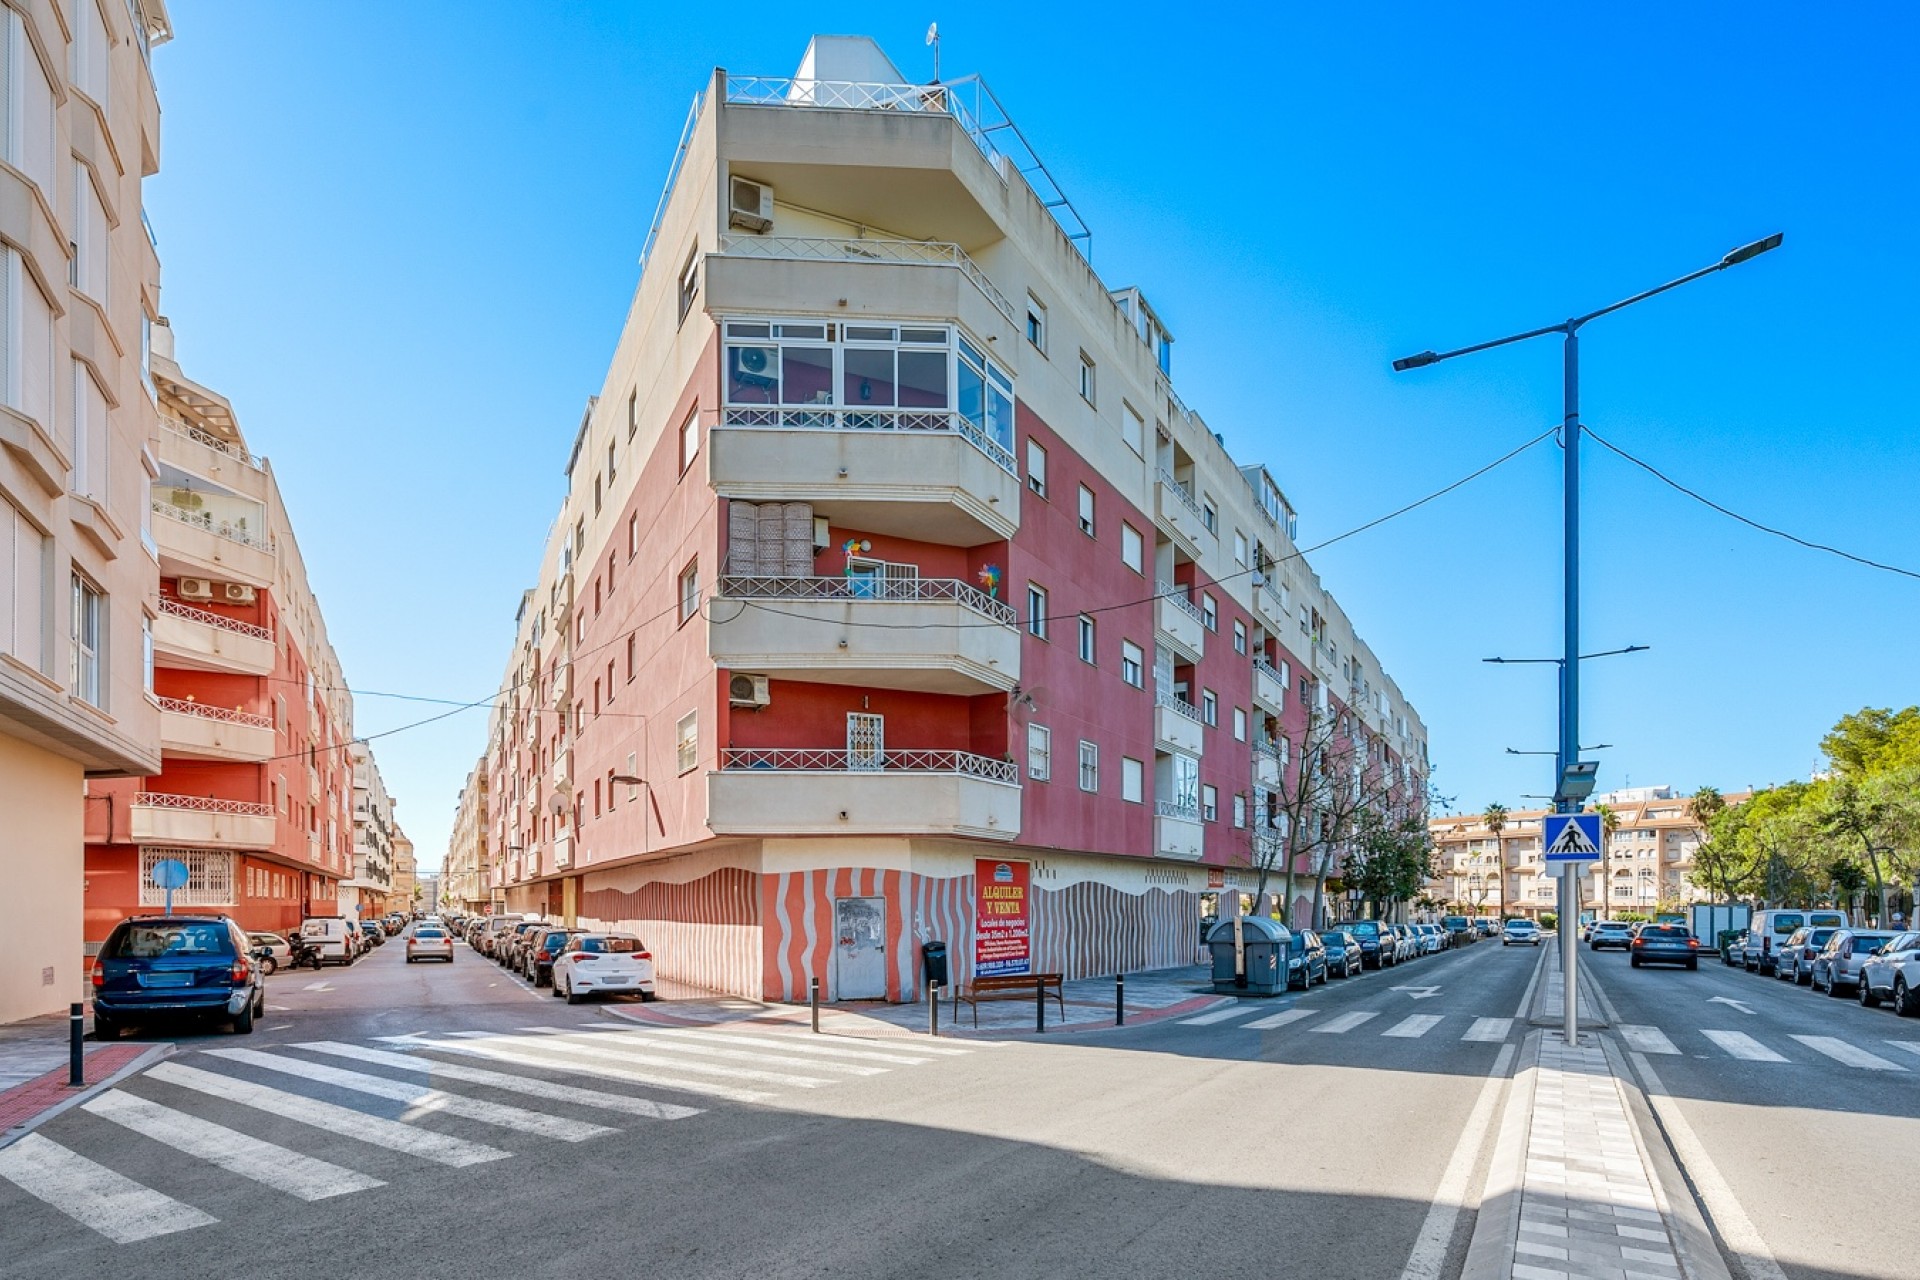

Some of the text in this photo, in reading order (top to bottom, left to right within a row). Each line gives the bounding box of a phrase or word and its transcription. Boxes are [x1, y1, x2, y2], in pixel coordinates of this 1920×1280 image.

[983, 885, 1024, 899] ALQUILER
[986, 901, 1021, 914] Y VENTA
[981, 917, 1025, 929] Locales de negocios
